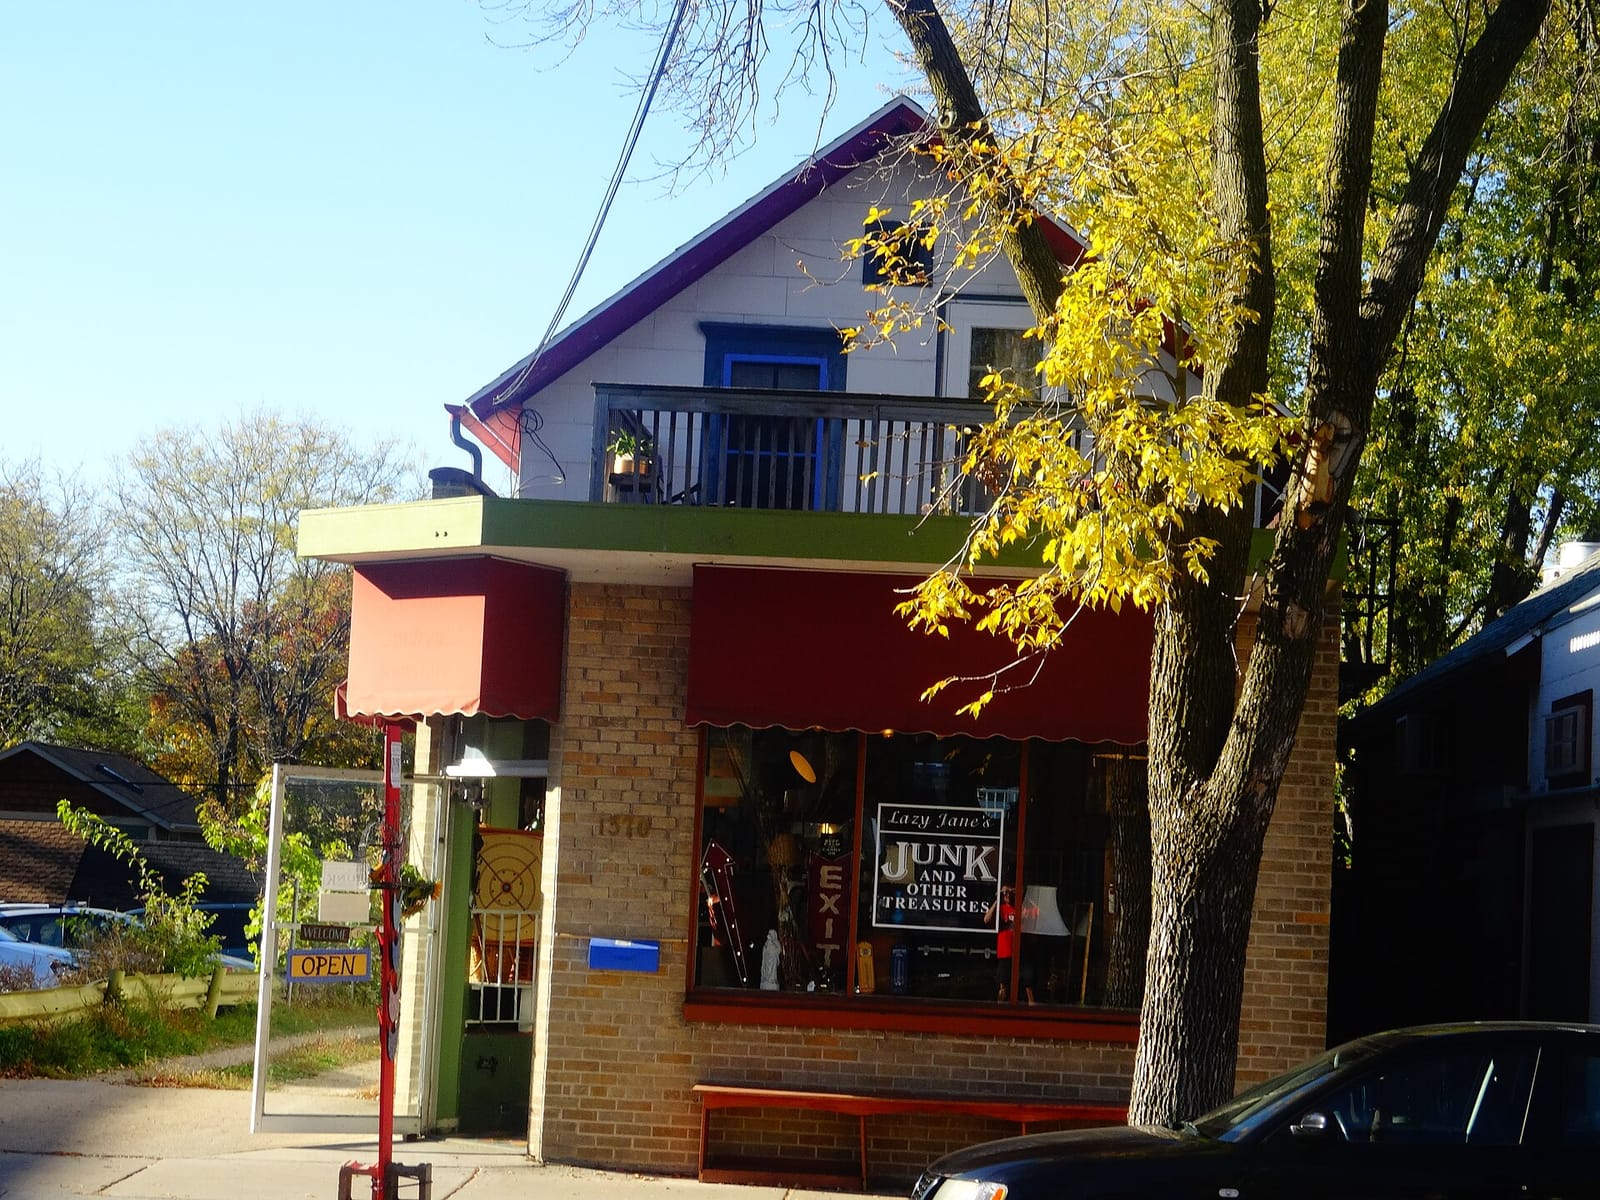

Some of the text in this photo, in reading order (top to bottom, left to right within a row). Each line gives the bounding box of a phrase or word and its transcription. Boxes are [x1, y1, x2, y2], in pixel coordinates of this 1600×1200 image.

[888, 810, 992, 829] Lazy Jane's
[880, 841, 997, 882] JUNK
[920, 869, 956, 883] AND
[906, 883, 967, 898] OTHER
[883, 896, 990, 913] TREASURES
[816, 865, 843, 967] EXIT
[302, 927, 347, 940] WELCOME
[301, 955, 356, 976] OPEN
